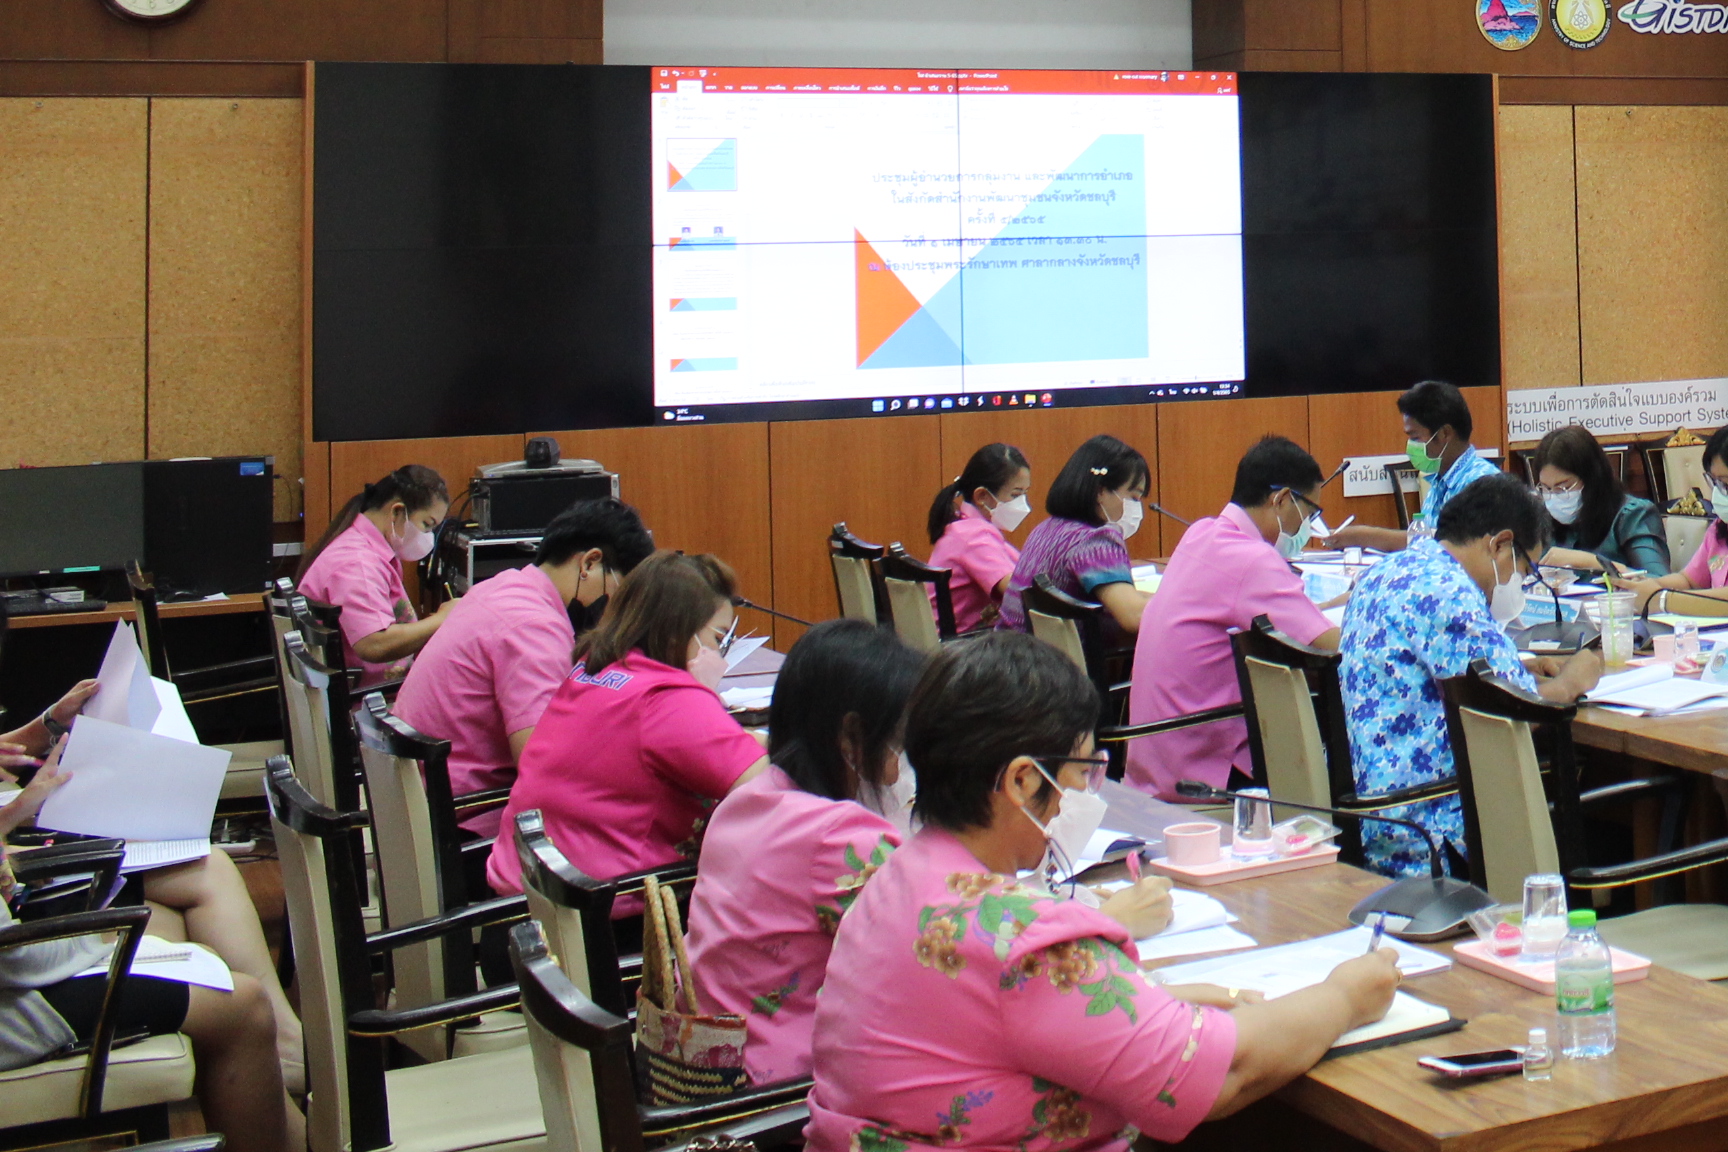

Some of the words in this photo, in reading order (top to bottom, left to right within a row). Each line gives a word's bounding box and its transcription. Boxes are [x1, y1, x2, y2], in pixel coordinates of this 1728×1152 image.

[1507, 386, 1717, 415] ระบบเพื่อการตัดสินใจแบบองค์รวม
[1507, 418, 1562, 436] (Holistic
[1640, 408, 1692, 427] Support
